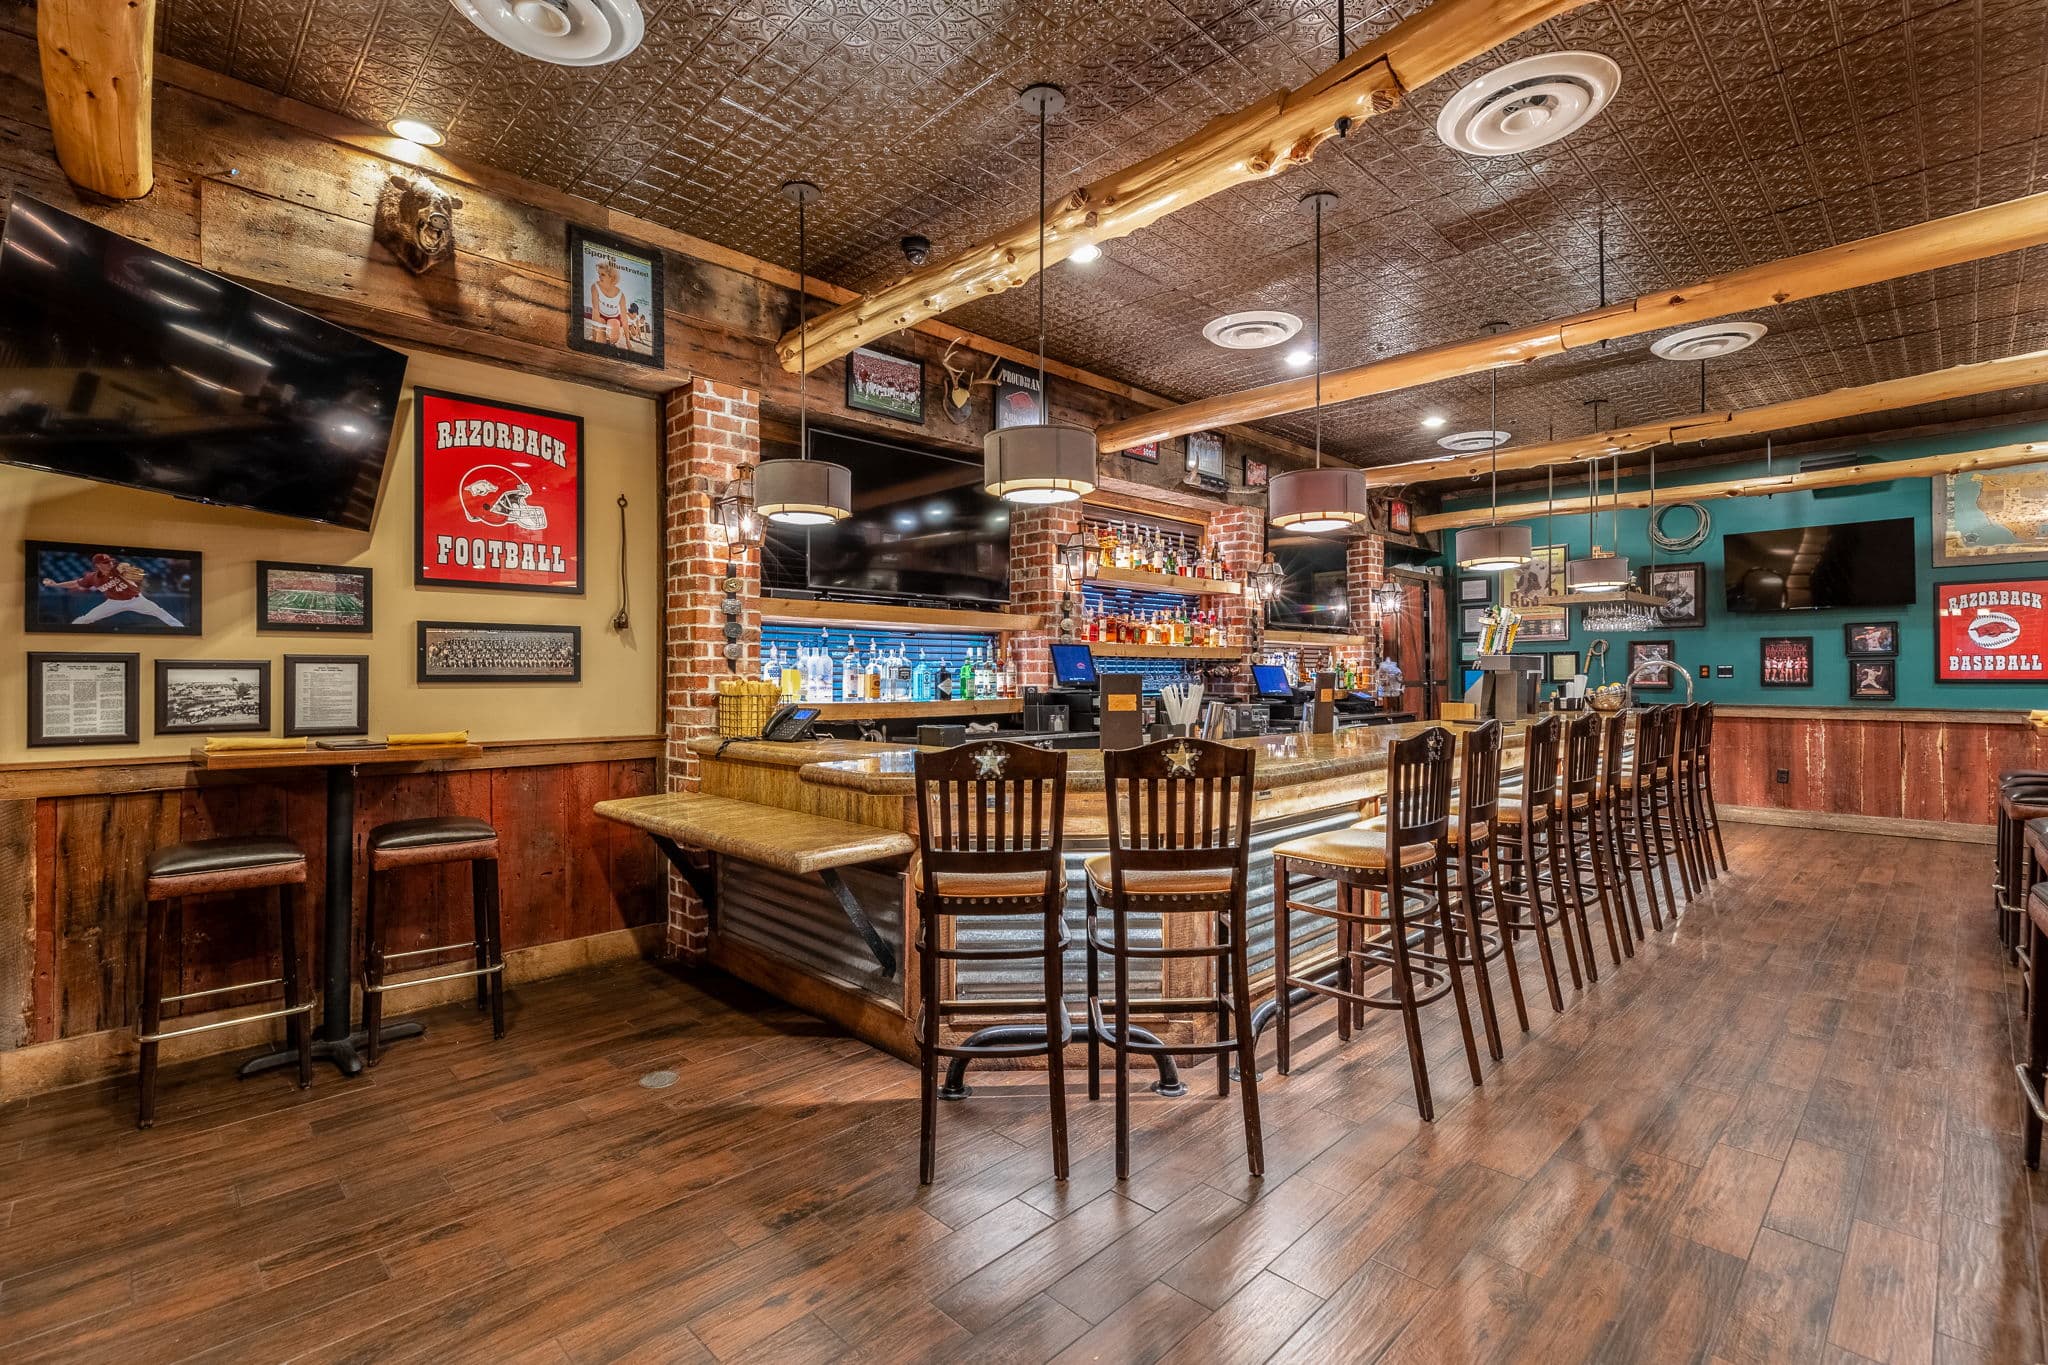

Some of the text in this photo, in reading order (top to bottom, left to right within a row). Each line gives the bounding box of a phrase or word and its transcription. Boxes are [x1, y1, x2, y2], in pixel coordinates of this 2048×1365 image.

[584, 247, 617, 263] Sports
[608, 260, 649, 278] Illustrated
[1002, 368, 1024, 387] PROUD
[437, 419, 566, 468] RAZORBACK
[437, 535, 566, 574] FOOTBALL
[1948, 590, 2043, 612] RAZORBACK
[1949, 654, 2043, 672] BASEBALL
